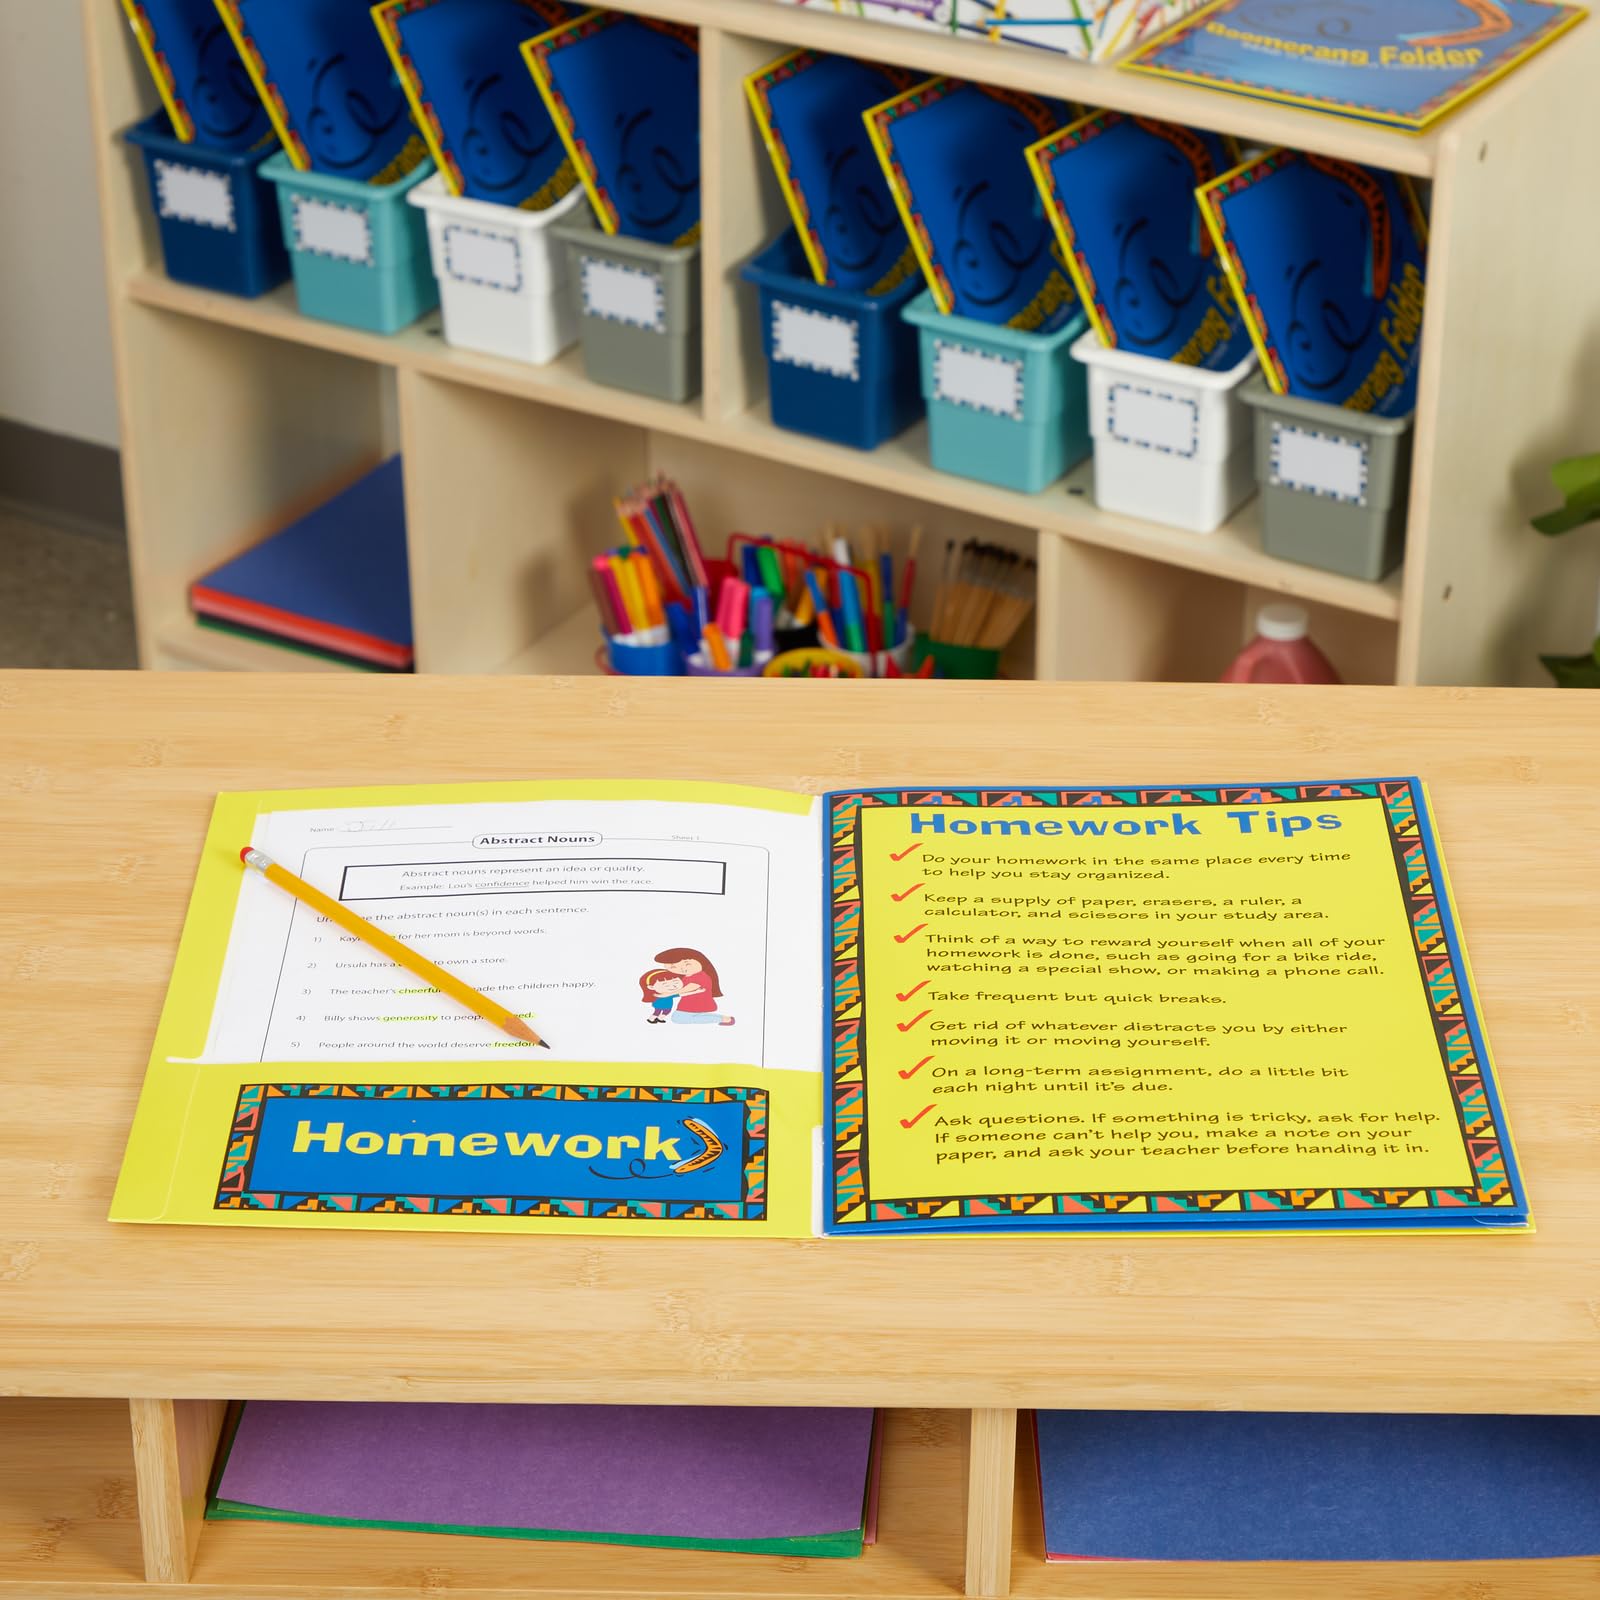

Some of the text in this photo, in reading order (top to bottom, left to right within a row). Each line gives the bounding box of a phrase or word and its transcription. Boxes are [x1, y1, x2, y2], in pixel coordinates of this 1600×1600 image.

[1206, 21, 1485, 66] Boomerang Folder
[911, 810, 1343, 838] Homework Tips
[479, 834, 596, 846] Abstract Nouns
[922, 854, 945, 863] Do
[950, 857, 991, 866] your
[996, 855, 1086, 865] homework
[1092, 857, 1108, 865] in
[1115, 856, 1144, 866] the
[1206, 855, 1252, 868] place
[1258, 855, 1304, 865] every
[1309, 852, 1351, 862] time
[401, 869, 449, 878] Abstract
[489, 866, 543, 876] represent
[562, 865, 587, 873] idea
[603, 864, 646, 873] quality.
[923, 868, 1170, 881] to help you stay organized.
[448, 881, 473, 889] Lou's
[474, 880, 530, 890] confidence
[532, 879, 568, 887] helped
[924, 893, 968, 906] Keep
[991, 896, 1051, 908] supply
[1056, 896, 1075, 905] of
[1081, 899, 1137, 909] paper,
[1142, 899, 1217, 907] erasers,
[1240, 896, 1285, 906] ruler,
[375, 913, 395, 921] the
[396, 911, 444, 920] abstract
[445, 908, 489, 918] noun(s)
[491, 908, 503, 916] in
[505, 907, 533, 916] each
[535, 907, 590, 915] sentence.
[398, 933, 413, 941] for
[414, 932, 432, 940] her
[472, 929, 512, 937] beyond
[926, 934, 974, 944] Think
[980, 935, 1000, 944] of
[1022, 938, 1057, 949] way
[1064, 937, 1084, 946] to
[1090, 938, 1151, 947] reward
[1157, 938, 1234, 949] yourself
[1239, 938, 1285, 948] when
[1292, 938, 1313, 948] all
[1319, 937, 1339, 947] of
[1343, 938, 1385, 949] your
[335, 961, 368, 969] Ursula
[927, 962, 1012, 974] watching
[1018, 965, 1029, 973] a
[1036, 964, 1102, 977] special
[1108, 965, 1161, 976] show,
[1193, 966, 1260, 978] making
[1284, 966, 1341, 979] phone
[1347, 965, 1384, 975] call.
[330, 988, 349, 996] The
[351, 987, 396, 995] teacher's
[498, 984, 515, 992] the
[517, 982, 560, 990] children
[928, 991, 1226, 1006] Take frequent but quick breaks.
[323, 1015, 347, 1023] Billy
[382, 1015, 439, 1023] generosity
[929, 1020, 1347, 1035] Get rid of whatever distracts you by either
[318, 1041, 355, 1049] People
[397, 1041, 416, 1049] the
[417, 1041, 448, 1049] world
[450, 1041, 492, 1049] deserve
[931, 1067, 958, 1078] On
[965, 1068, 977, 1076] a
[983, 1065, 1081, 1078] long-term
[1088, 1066, 1212, 1079] assignment,
[1218, 1066, 1243, 1076] do
[1268, 1066, 1315, 1077] little
[1321, 1067, 1349, 1077] bit
[934, 1111, 1440, 1129] Ask questions. If something is tricky, ask for help.
[292, 1119, 682, 1161] Homework
[936, 1143, 1429, 1165] paper, and ask your teacher before handing it in.
